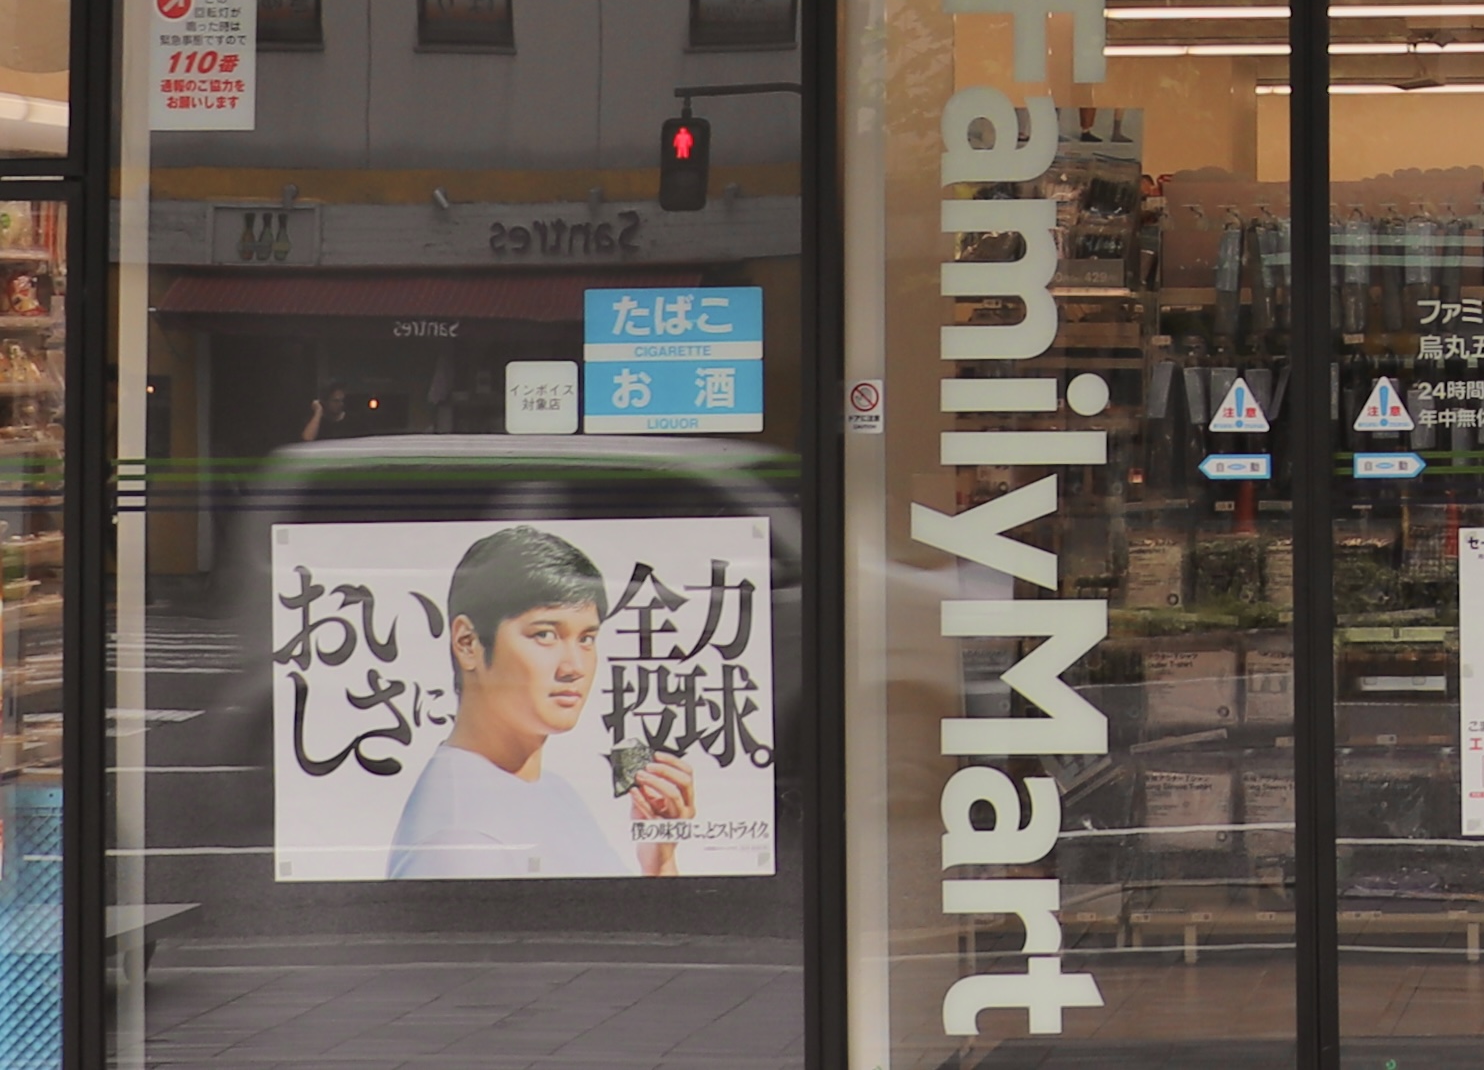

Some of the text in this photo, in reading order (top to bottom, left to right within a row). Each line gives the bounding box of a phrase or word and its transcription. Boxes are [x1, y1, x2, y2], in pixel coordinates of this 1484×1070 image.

[194, 7, 241, 18] 回転灯が
[160, 35, 247, 46] 緊急事態ですので
[168, 50, 240, 74] 110番
[160, 80, 246, 93] 通報のご協力を
[166, 96, 240, 109] お願いします
[611, 295, 733, 336] たばこ
[634, 346, 711, 358] CIGARETTE
[510, 384, 574, 397] インボイス
[521, 398, 561, 411] 対象店
[1222, 407, 1257, 418] 注意
[1367, 406, 1402, 417] 注意
[647, 418, 699, 430] LIQUOR
[273, 564, 445, 671] おい
[602, 559, 756, 665] 全力
